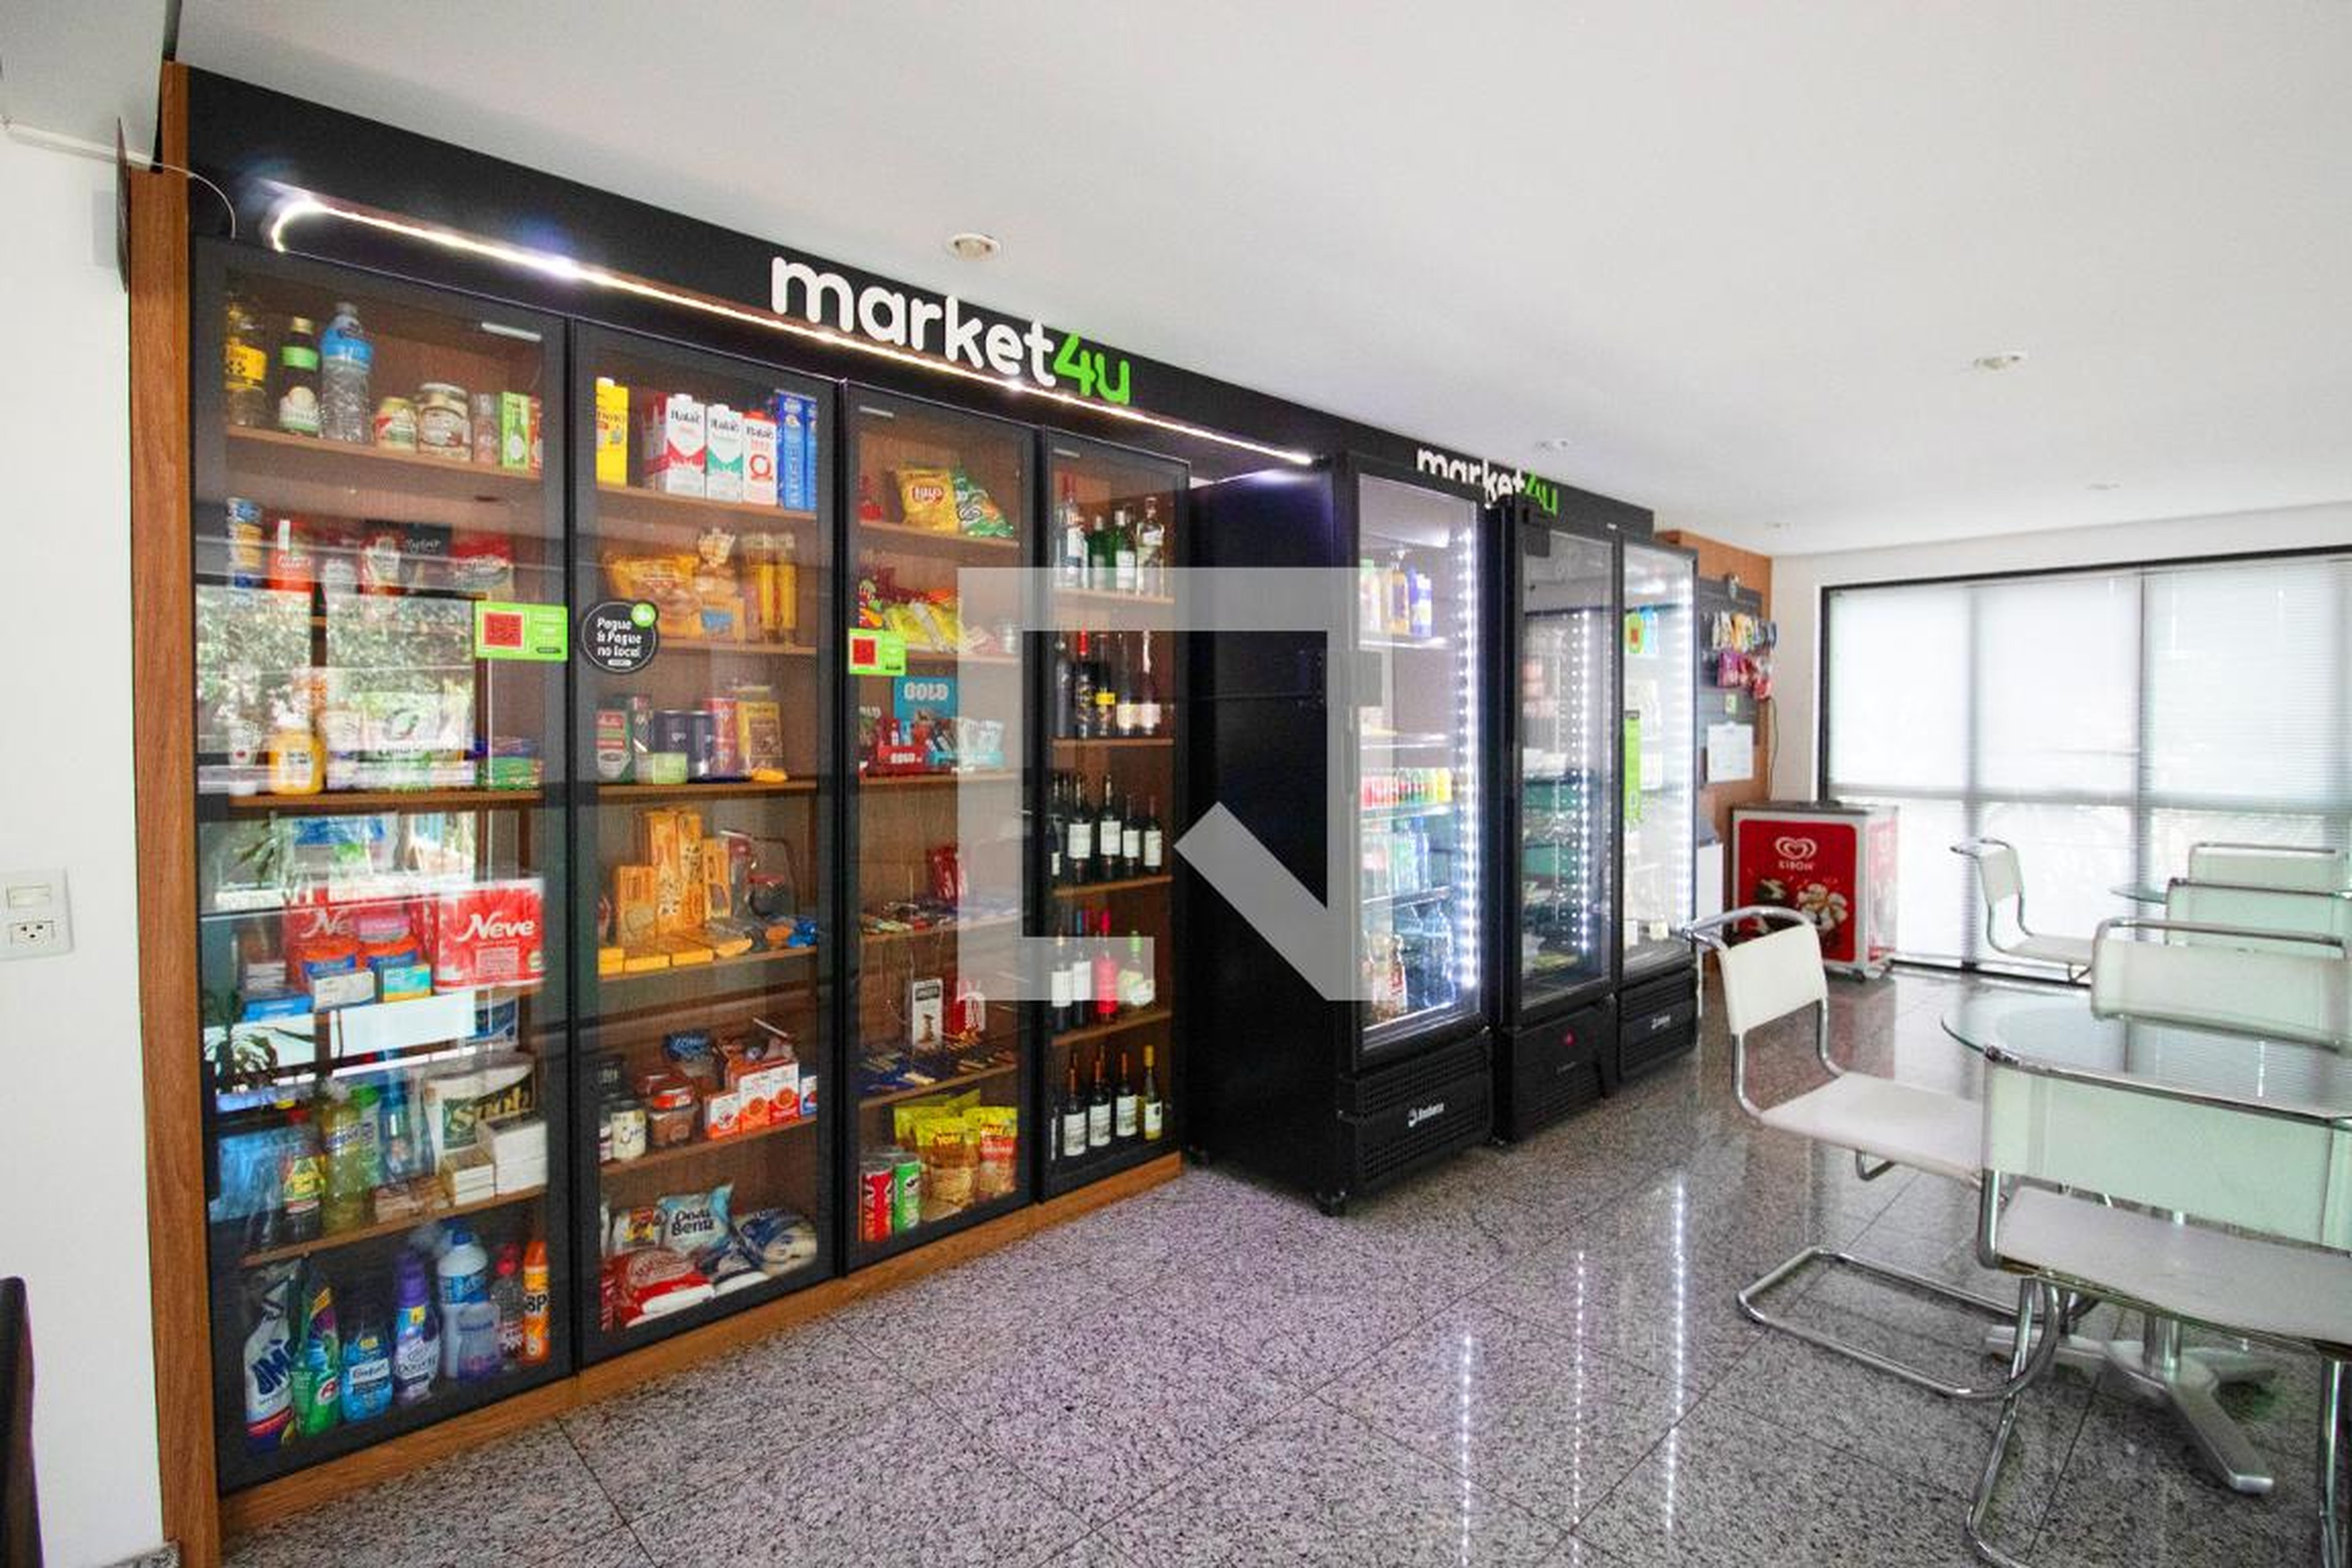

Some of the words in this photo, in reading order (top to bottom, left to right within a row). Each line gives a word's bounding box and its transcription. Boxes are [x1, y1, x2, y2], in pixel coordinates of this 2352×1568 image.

[771, 255, 1130, 405] market4u
[597, 646, 612, 656] no
[903, 681, 949, 701] GOLD
[455, 911, 534, 942] Neve
